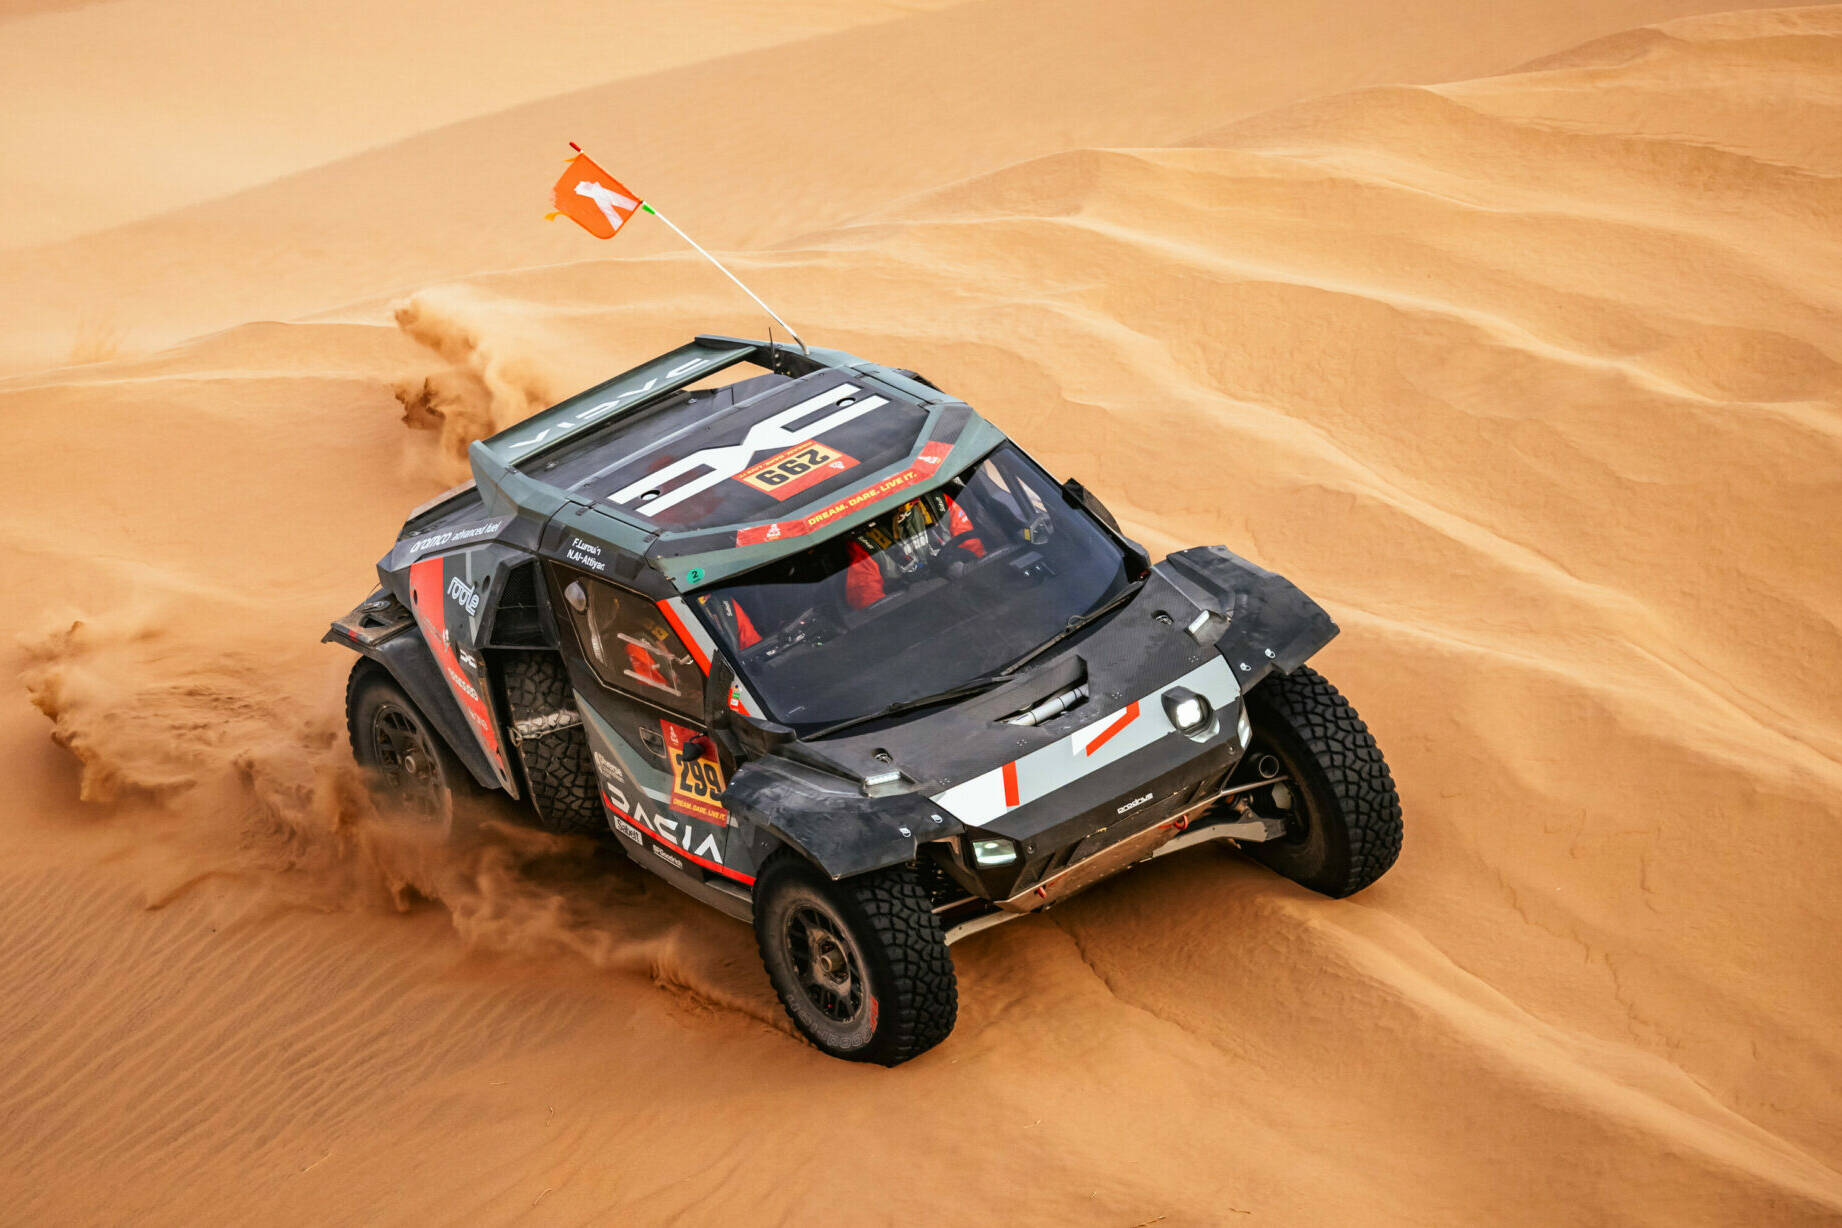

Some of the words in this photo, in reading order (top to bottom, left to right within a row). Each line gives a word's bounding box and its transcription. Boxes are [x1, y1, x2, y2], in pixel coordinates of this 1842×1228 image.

[755, 448, 830, 486] 299
[807, 504, 849, 526] DREAM.
[848, 489, 880, 507] DARE.
[880, 476, 903, 493] LIVE
[902, 471, 918, 484] IT.
[410, 531, 452, 554] aramco
[453, 523, 486, 541] advanced
[485, 520, 501, 533] fuel
[691, 570, 699, 579] 2
[676, 753, 722, 802] 299
[607, 782, 723, 864] DACIA
[616, 818, 641, 844] Sabelt
